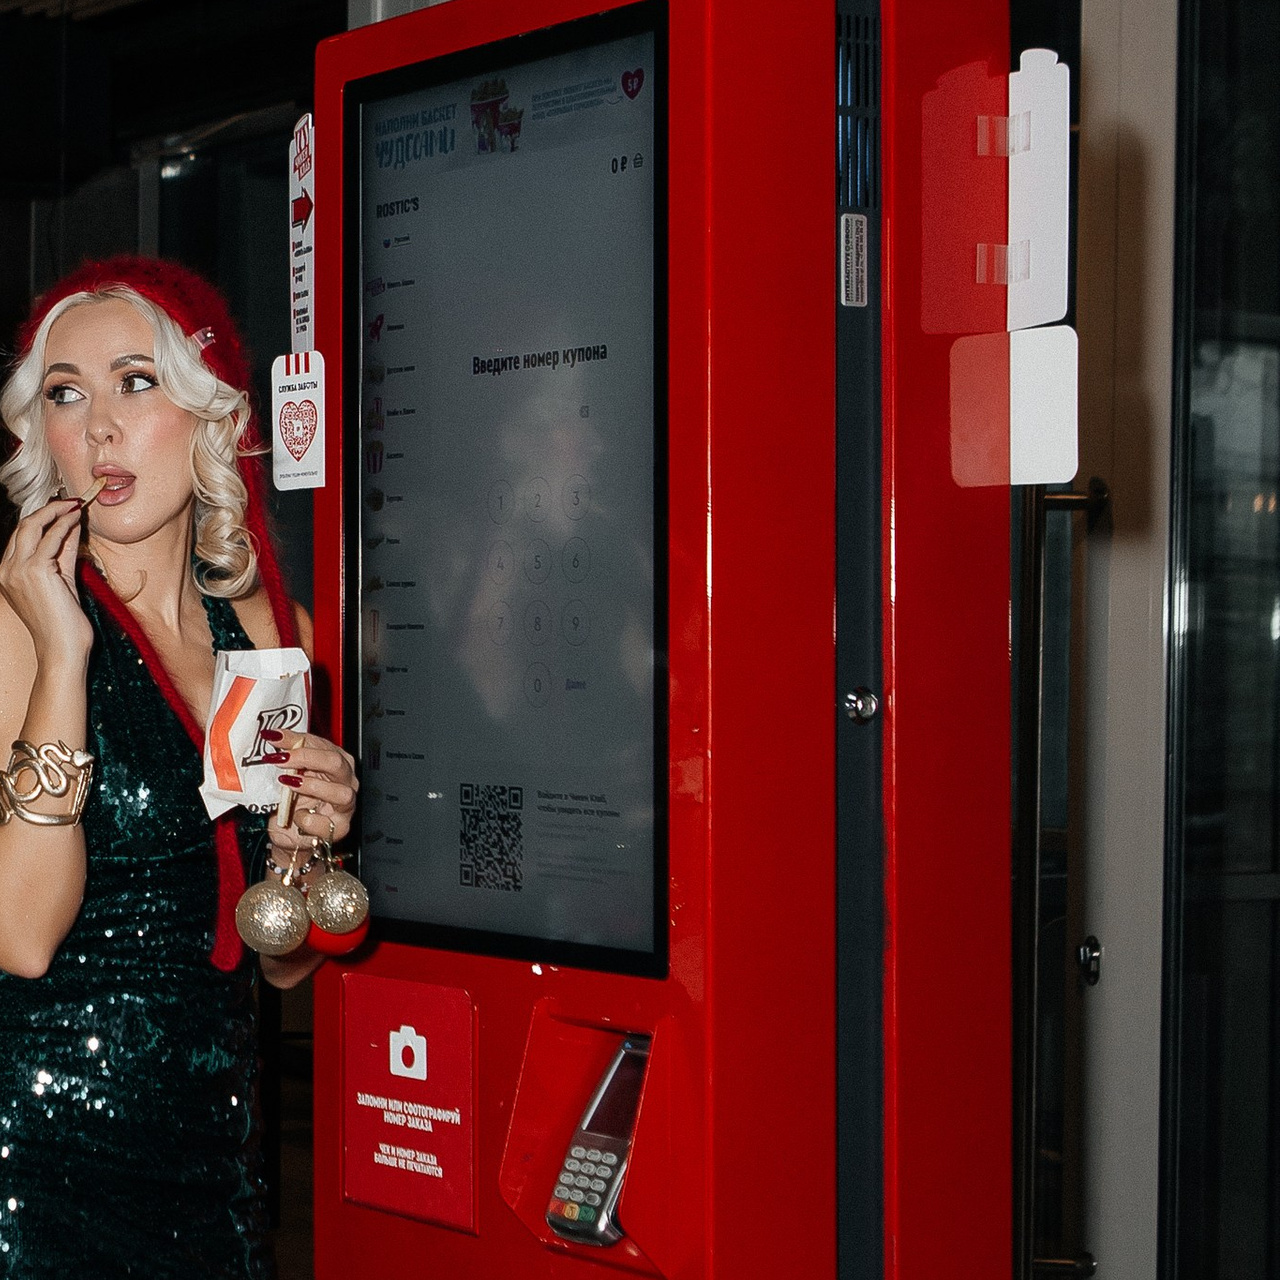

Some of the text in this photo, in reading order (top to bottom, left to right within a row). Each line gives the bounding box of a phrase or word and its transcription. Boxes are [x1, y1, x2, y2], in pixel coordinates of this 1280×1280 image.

[611, 157, 618, 174] 0
[376, 197, 420, 219] ROSTIC'S
[472, 344, 607, 376] Введите номер купона
[533, 493, 542, 508] 2
[572, 490, 580, 506] 3
[496, 553, 580, 571] 4 5 6
[533, 616, 542, 632] 8
[571, 616, 580, 631] 9
[533, 678, 542, 694] 0
[383, 1110, 433, 1132] НОМЕР ЗАКАЗА
